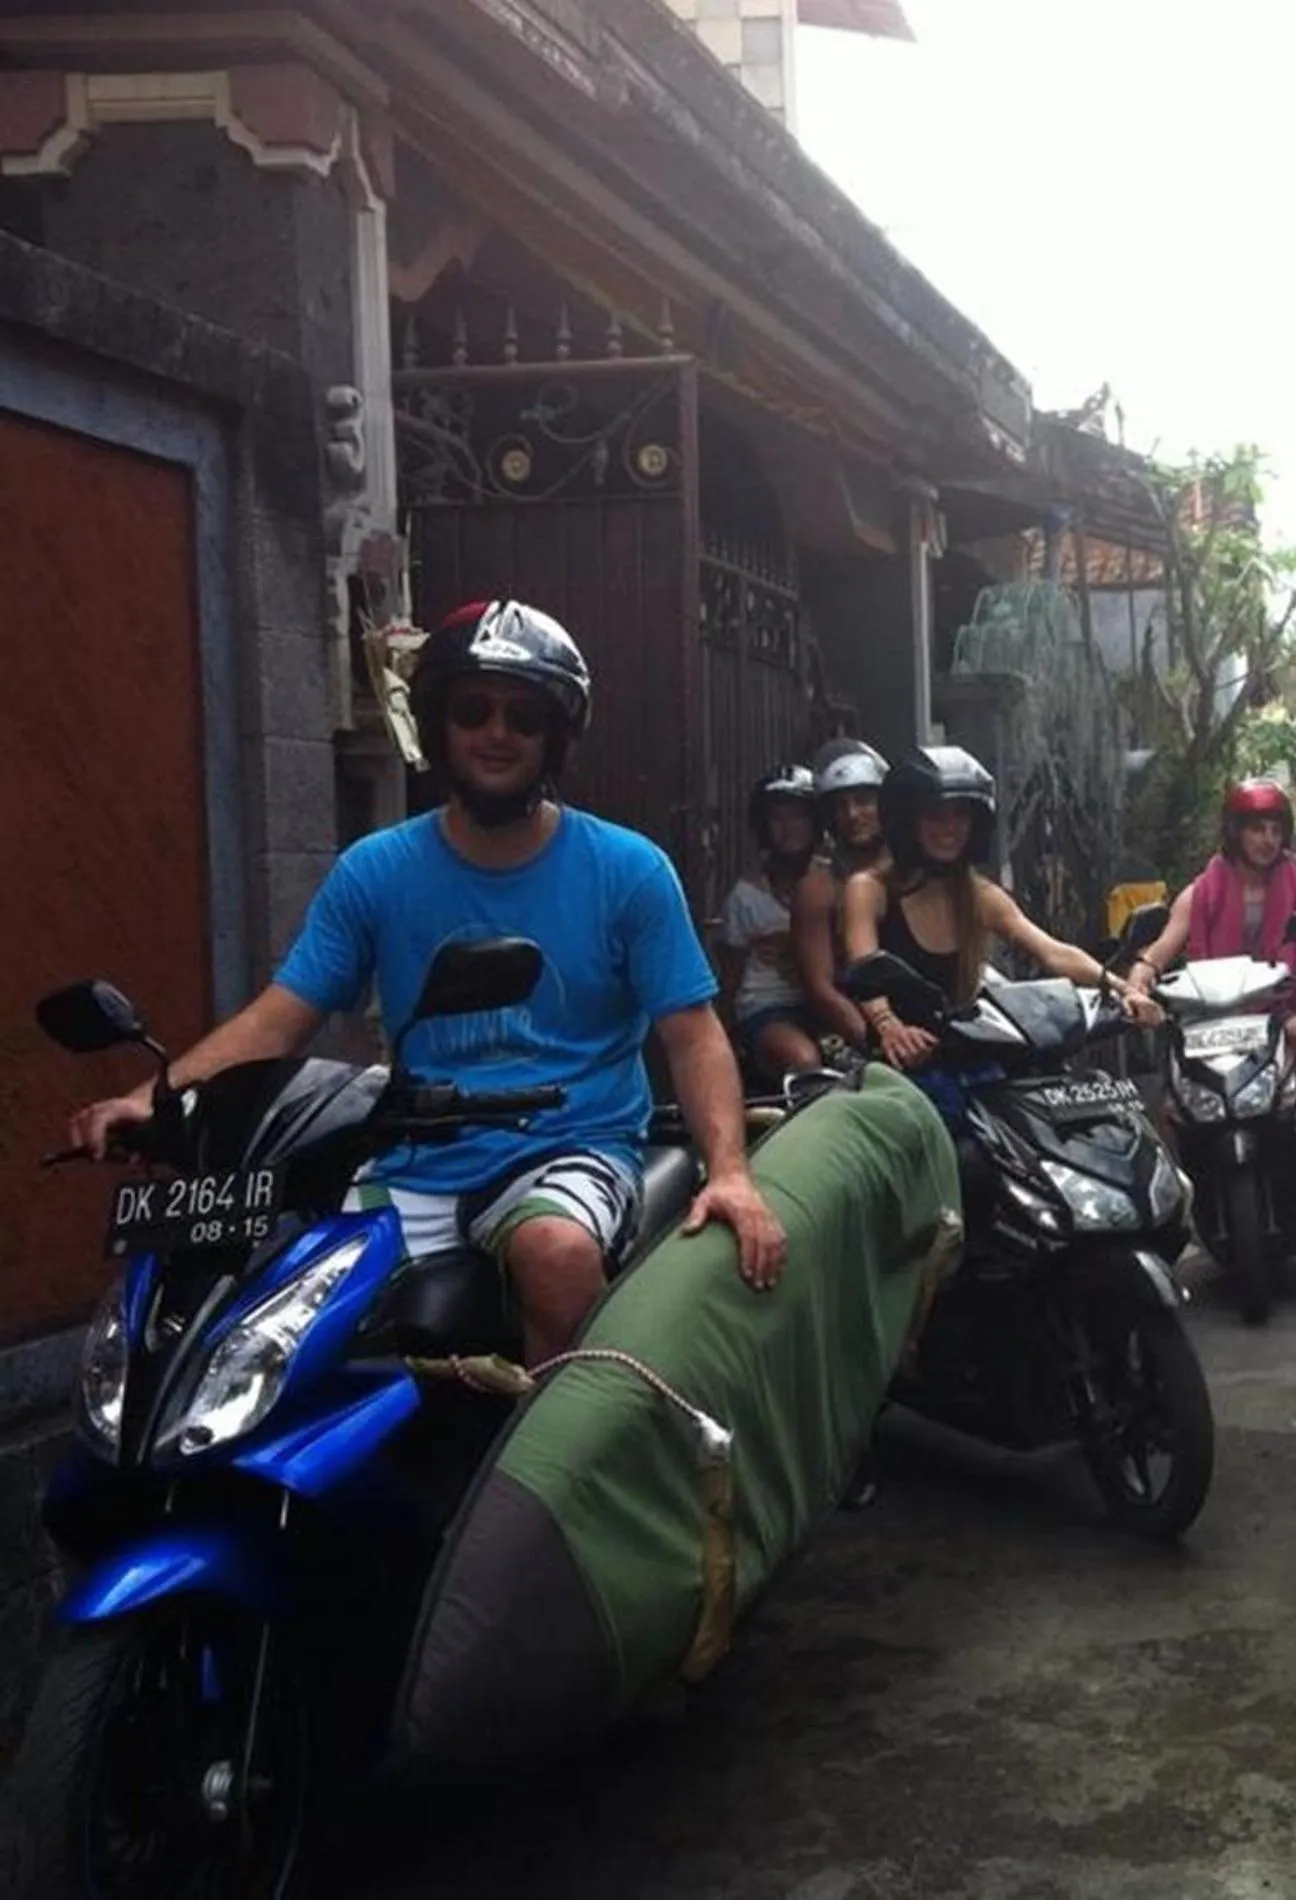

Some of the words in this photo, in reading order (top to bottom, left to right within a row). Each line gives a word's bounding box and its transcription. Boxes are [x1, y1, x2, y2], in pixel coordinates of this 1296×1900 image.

[116, 1184, 156, 1225] DK
[165, 1172, 237, 1218] 2164
[244, 1169, 274, 1209] IR
